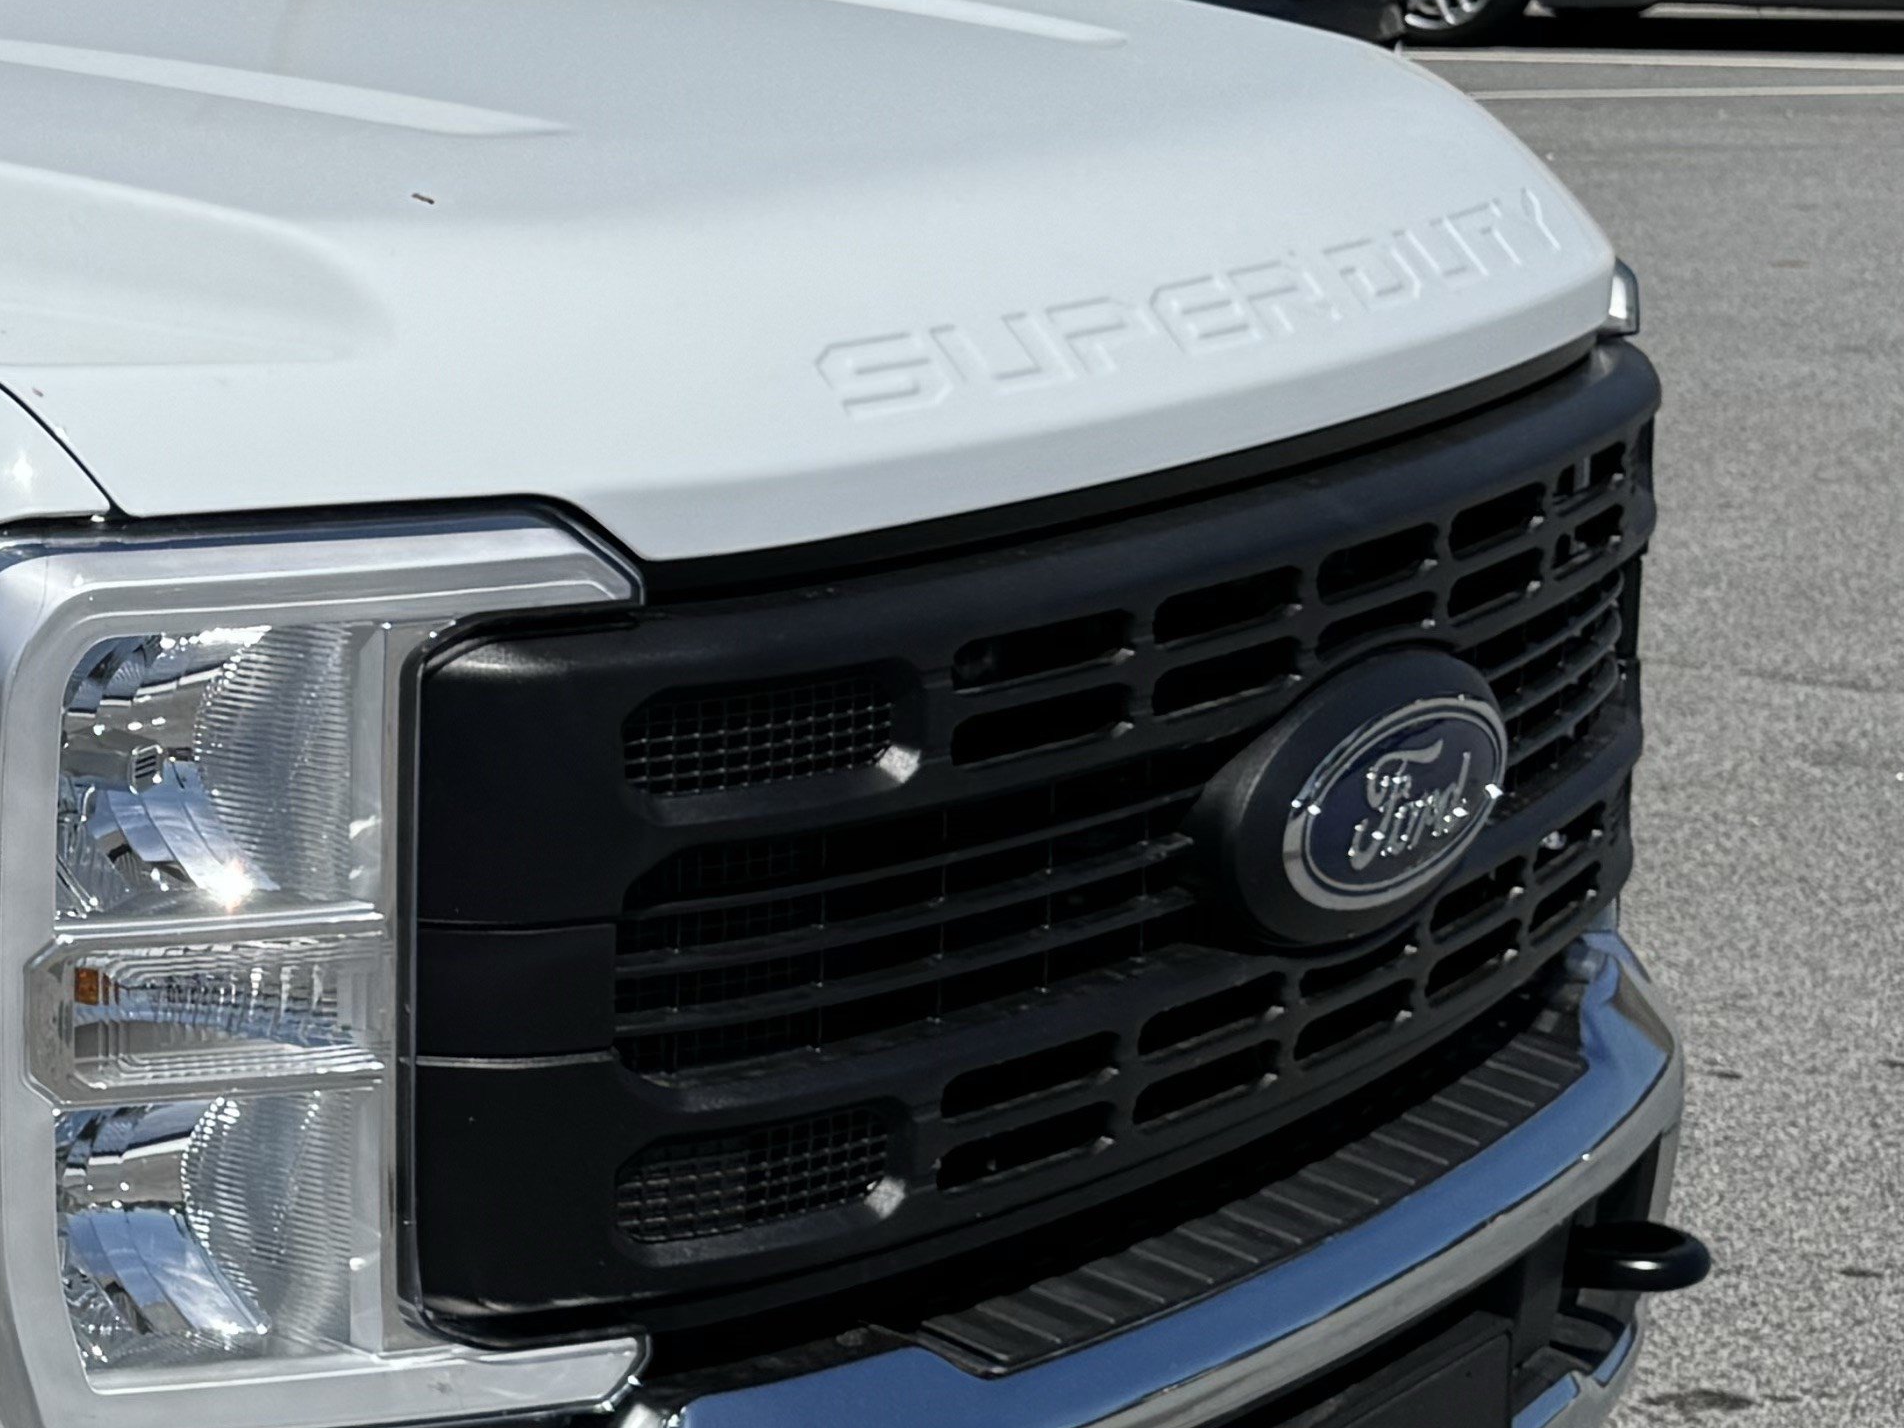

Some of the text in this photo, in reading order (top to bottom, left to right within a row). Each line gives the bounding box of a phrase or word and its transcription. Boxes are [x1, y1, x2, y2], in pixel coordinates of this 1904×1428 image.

[814, 186, 1563, 420] SUPER DUTY
[1349, 737, 1473, 871] Ford
